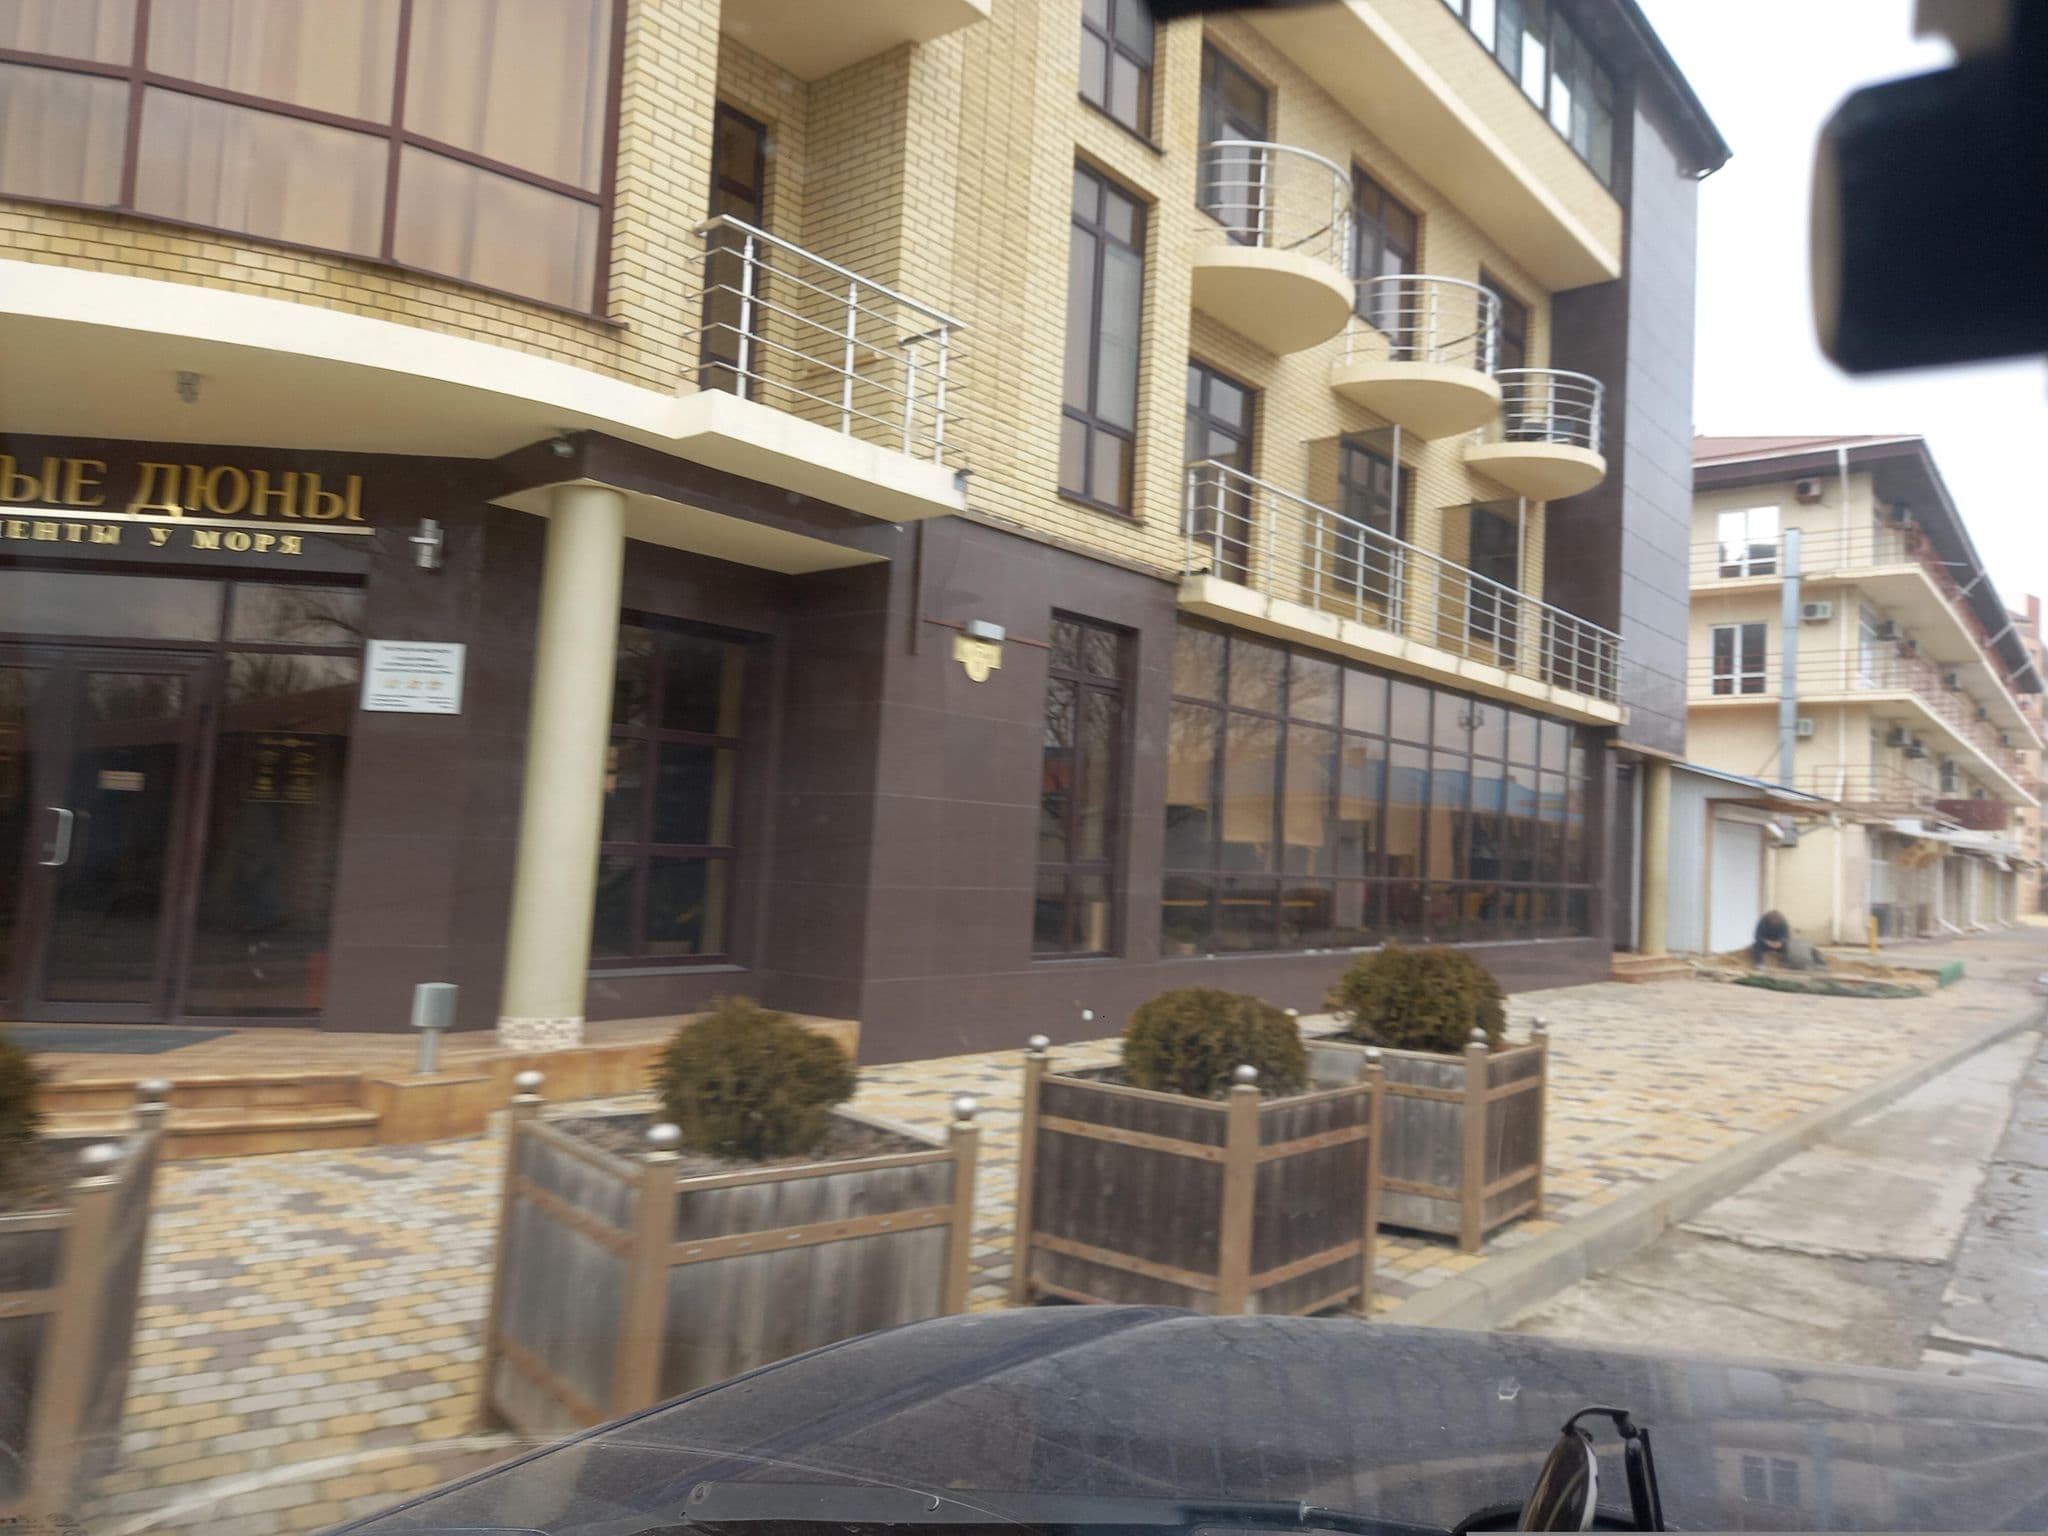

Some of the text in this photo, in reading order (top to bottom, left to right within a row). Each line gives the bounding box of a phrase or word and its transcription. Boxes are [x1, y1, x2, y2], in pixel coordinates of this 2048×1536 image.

[0, 455, 366, 521] ЫЕ ДЮНЫ
[0, 520, 305, 555] ЕНТЫ У МОРЯ
